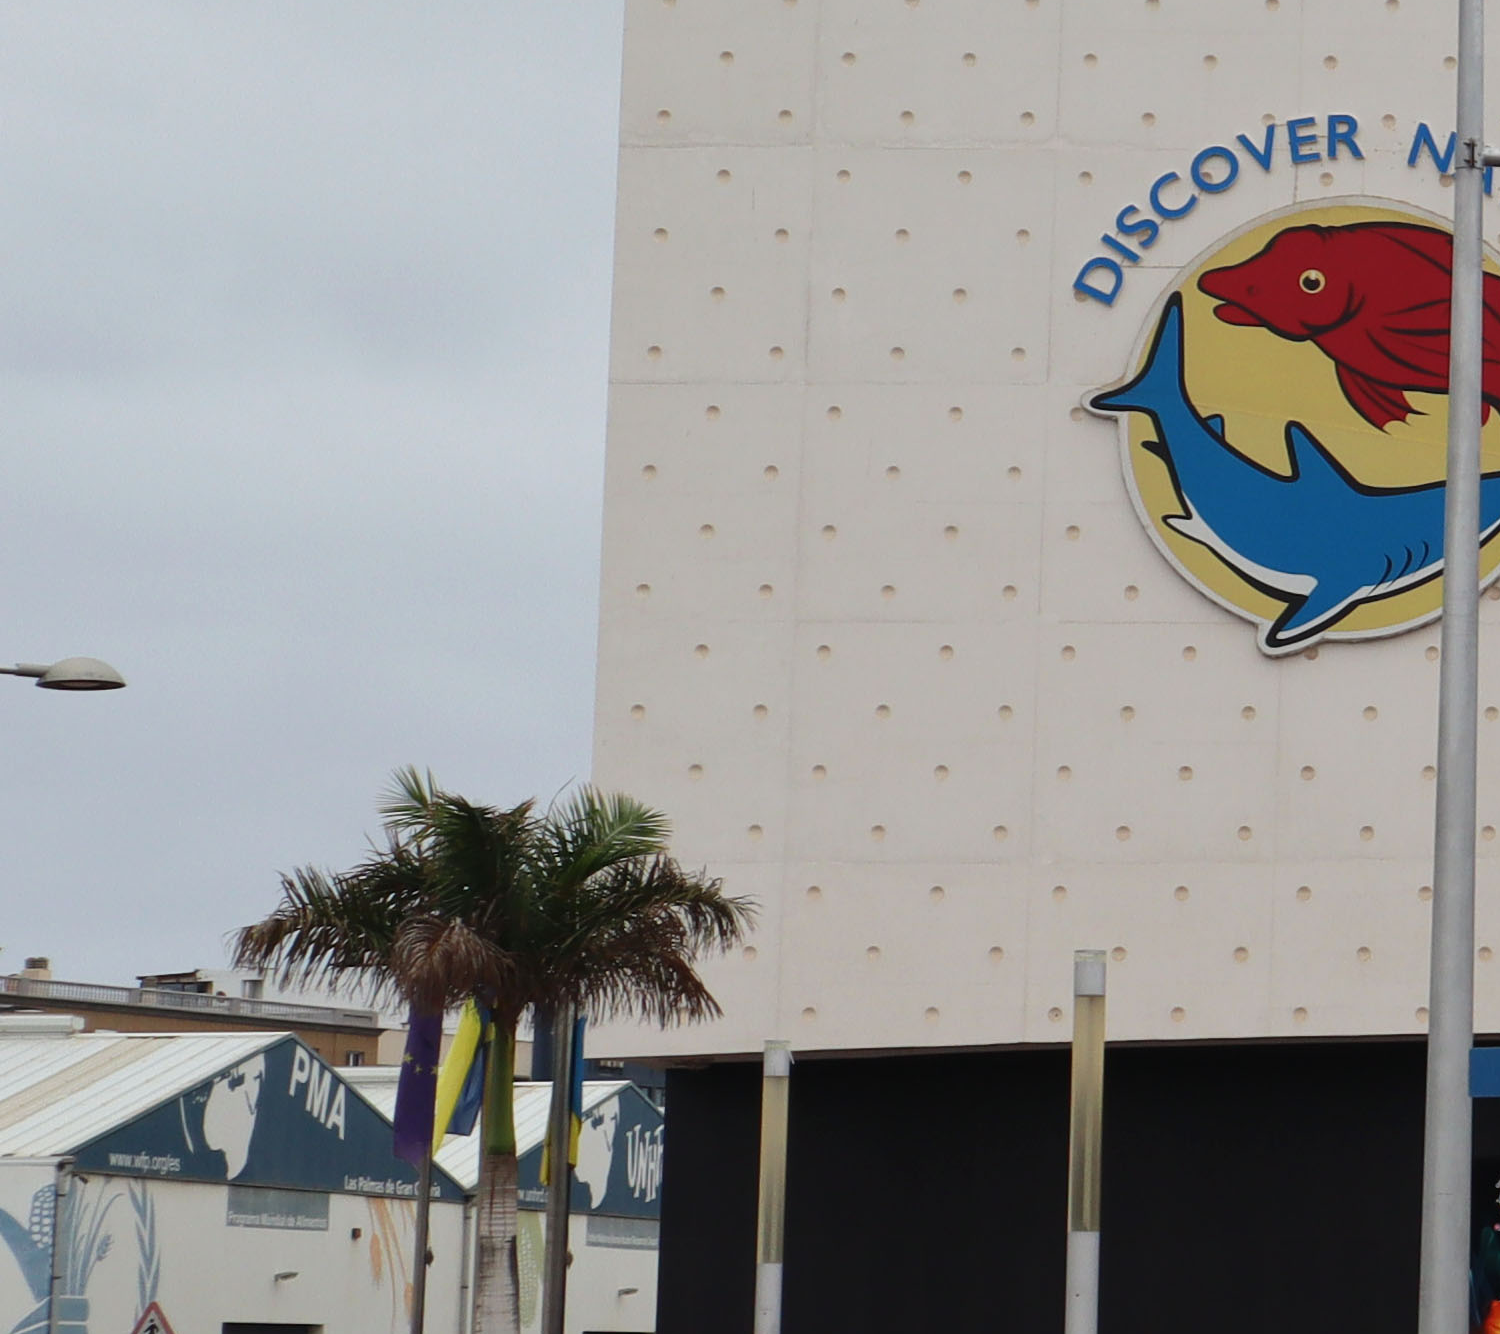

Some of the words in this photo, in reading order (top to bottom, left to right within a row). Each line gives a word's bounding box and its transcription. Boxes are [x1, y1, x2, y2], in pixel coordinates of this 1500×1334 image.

[1072, 113, 1364, 307] DISCOVER
[289, 1045, 347, 1141] PMA
[625, 1123, 664, 1203] UNH
